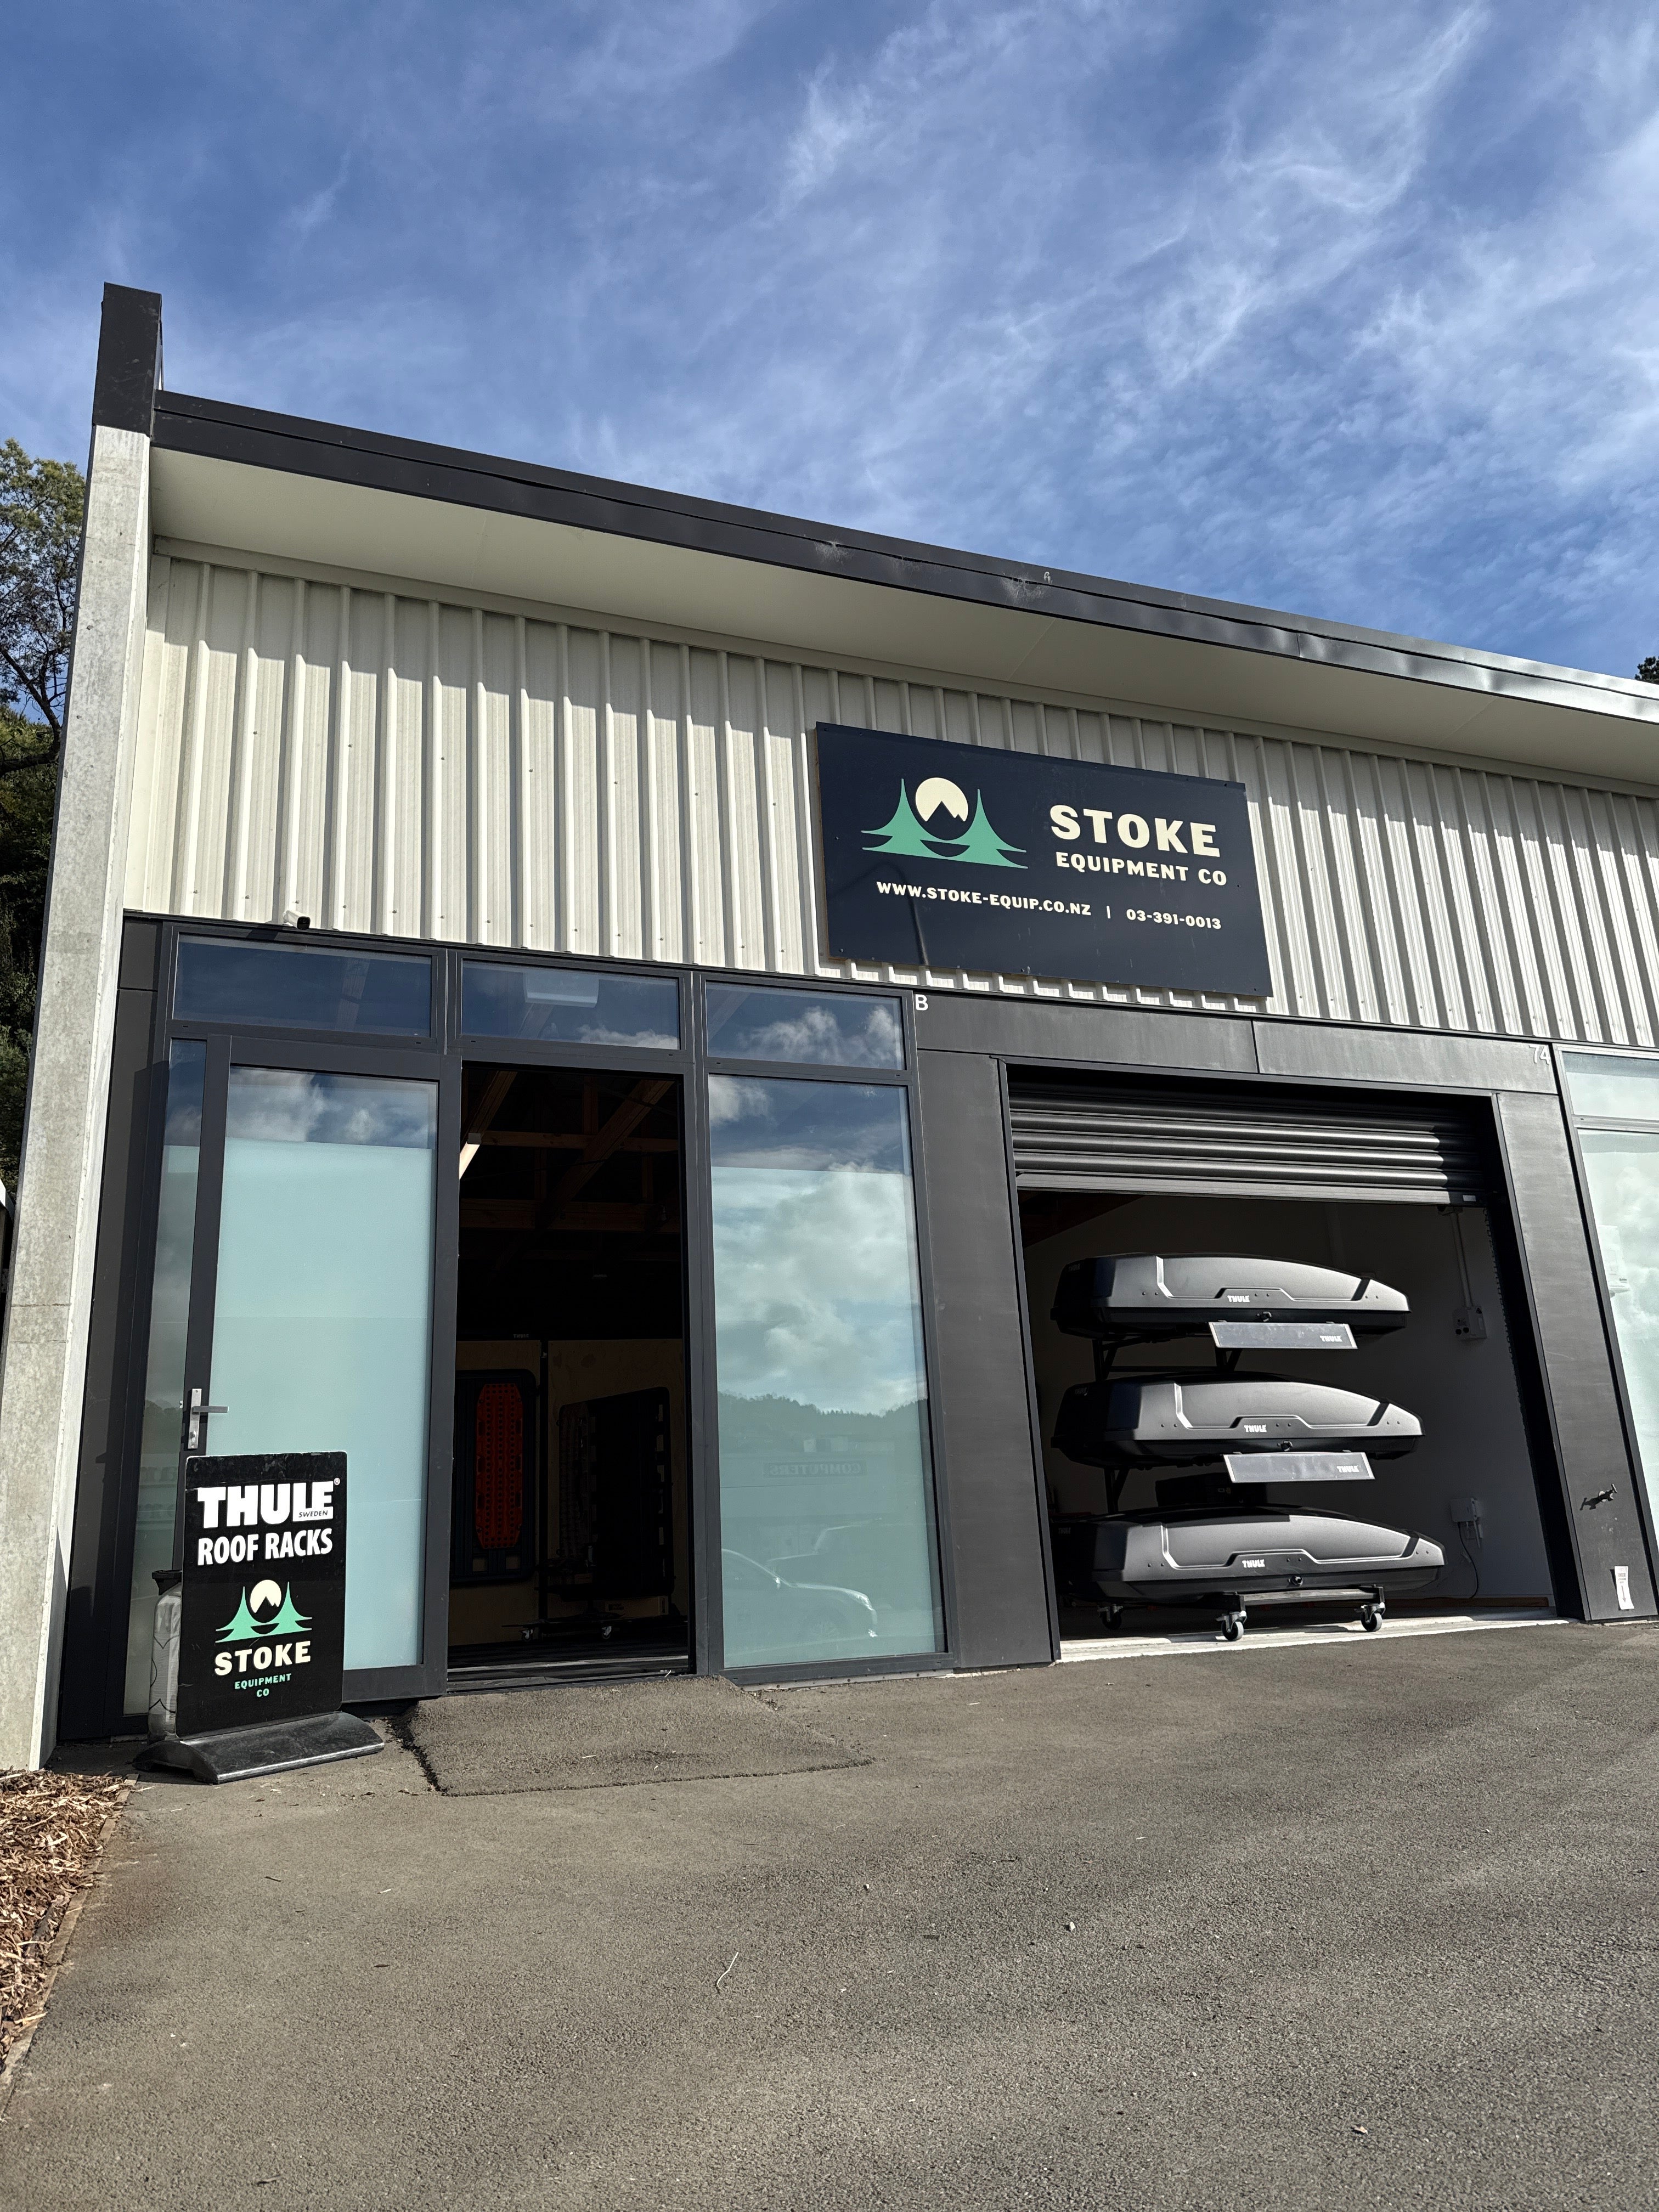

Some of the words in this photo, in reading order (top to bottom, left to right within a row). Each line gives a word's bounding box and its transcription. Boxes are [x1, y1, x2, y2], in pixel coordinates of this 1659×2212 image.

[1049, 805, 1220, 857] STOKE
[1056, 851, 1189, 881] EQUIPMENT
[1198, 868, 1227, 886] CO
[876, 881, 1091, 916] WWW.STOKE-EQUIP.CO.NZ
[1126, 909, 1221, 929] 03-391-0013
[915, 994, 929, 1011] B
[1529, 1045, 1551, 1064] 74
[1227, 1295, 1250, 1303] THULE
[1244, 1424, 1267, 1433] THULE
[197, 1481, 334, 1528] THULE
[198, 1533, 259, 1566] ROOF
[265, 1528, 333, 1560] RACKS
[1242, 1559, 1266, 1568] THULE
[215, 1640, 311, 1676] STOKE
[234, 1673, 292, 1690] EQUIPMENT
[256, 1688, 269, 1697] CO
